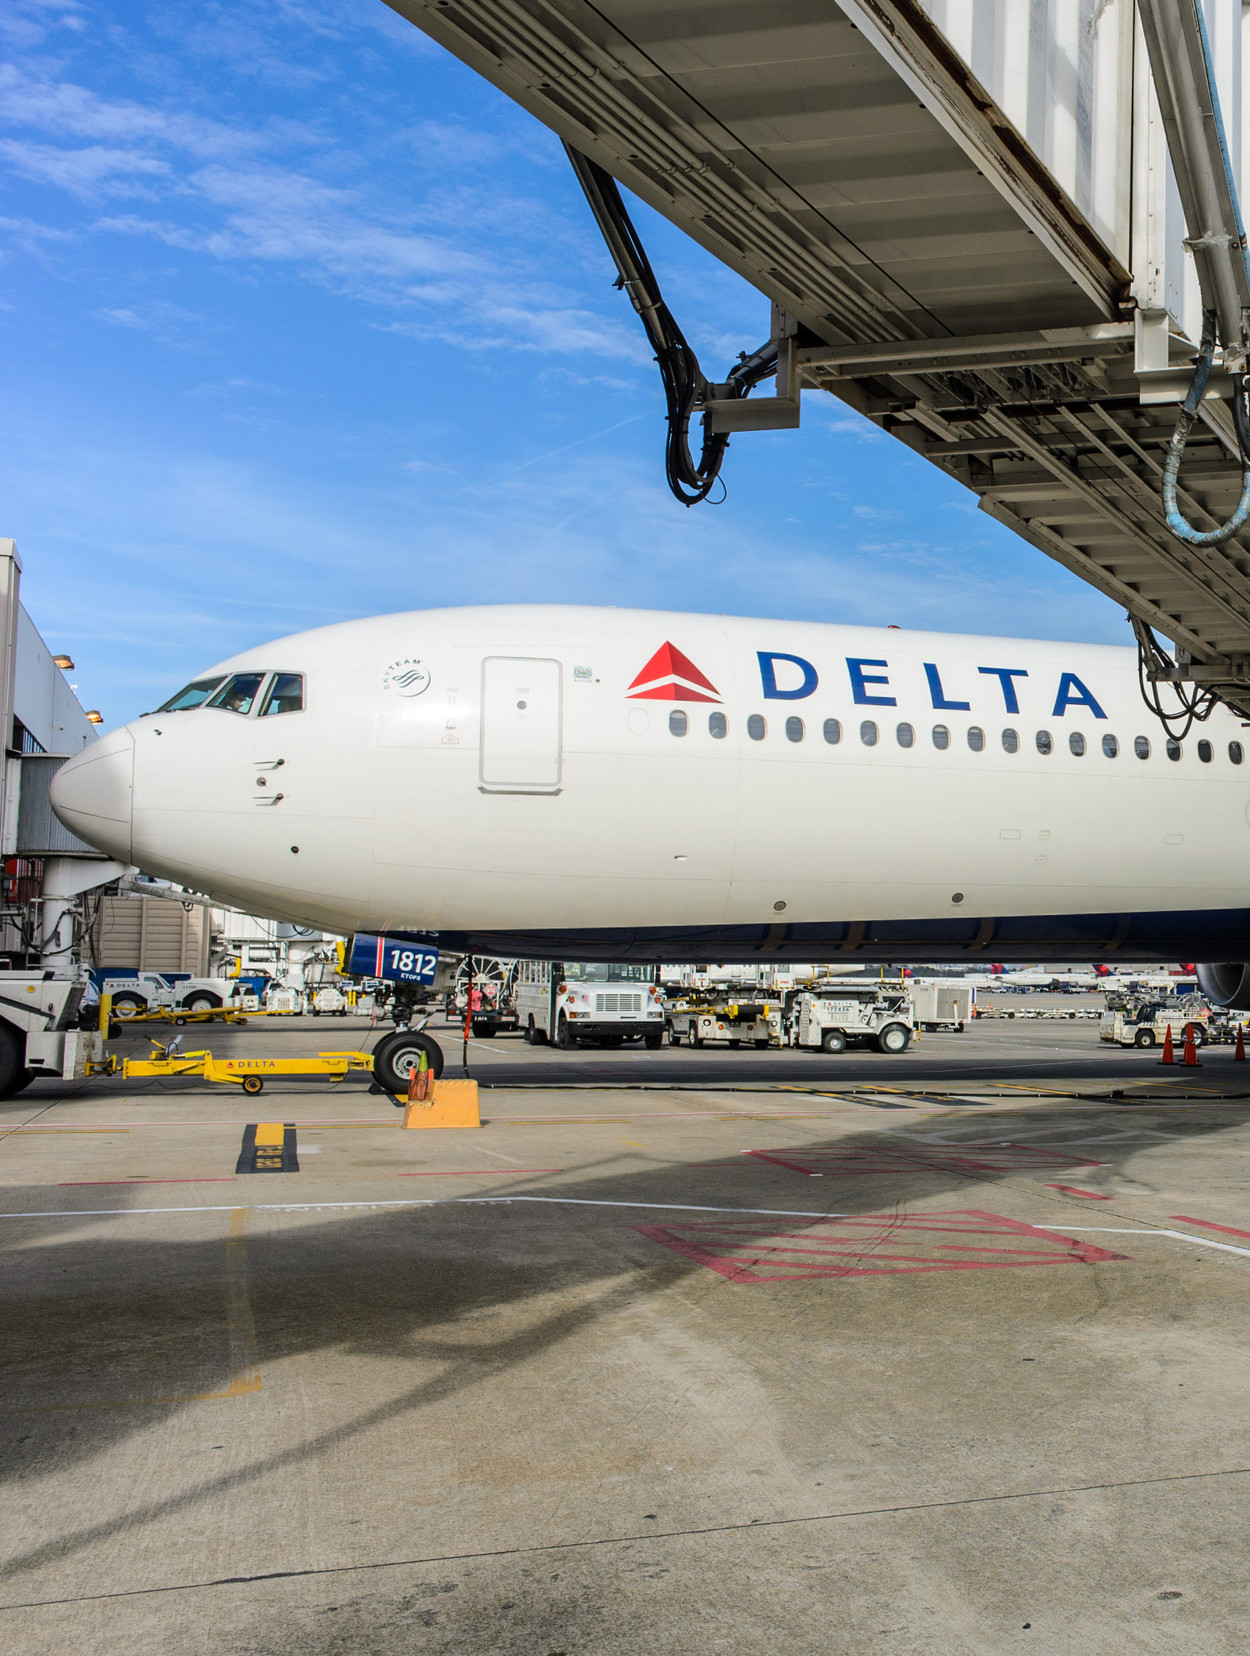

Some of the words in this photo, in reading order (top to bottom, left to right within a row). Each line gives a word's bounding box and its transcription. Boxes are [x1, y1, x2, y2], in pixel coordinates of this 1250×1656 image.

[382, 659, 422, 690] SKYTEAM
[756, 651, 1109, 720] DELTA
[391, 949, 437, 976] 1812
[400, 973, 421, 981] ETOPS
